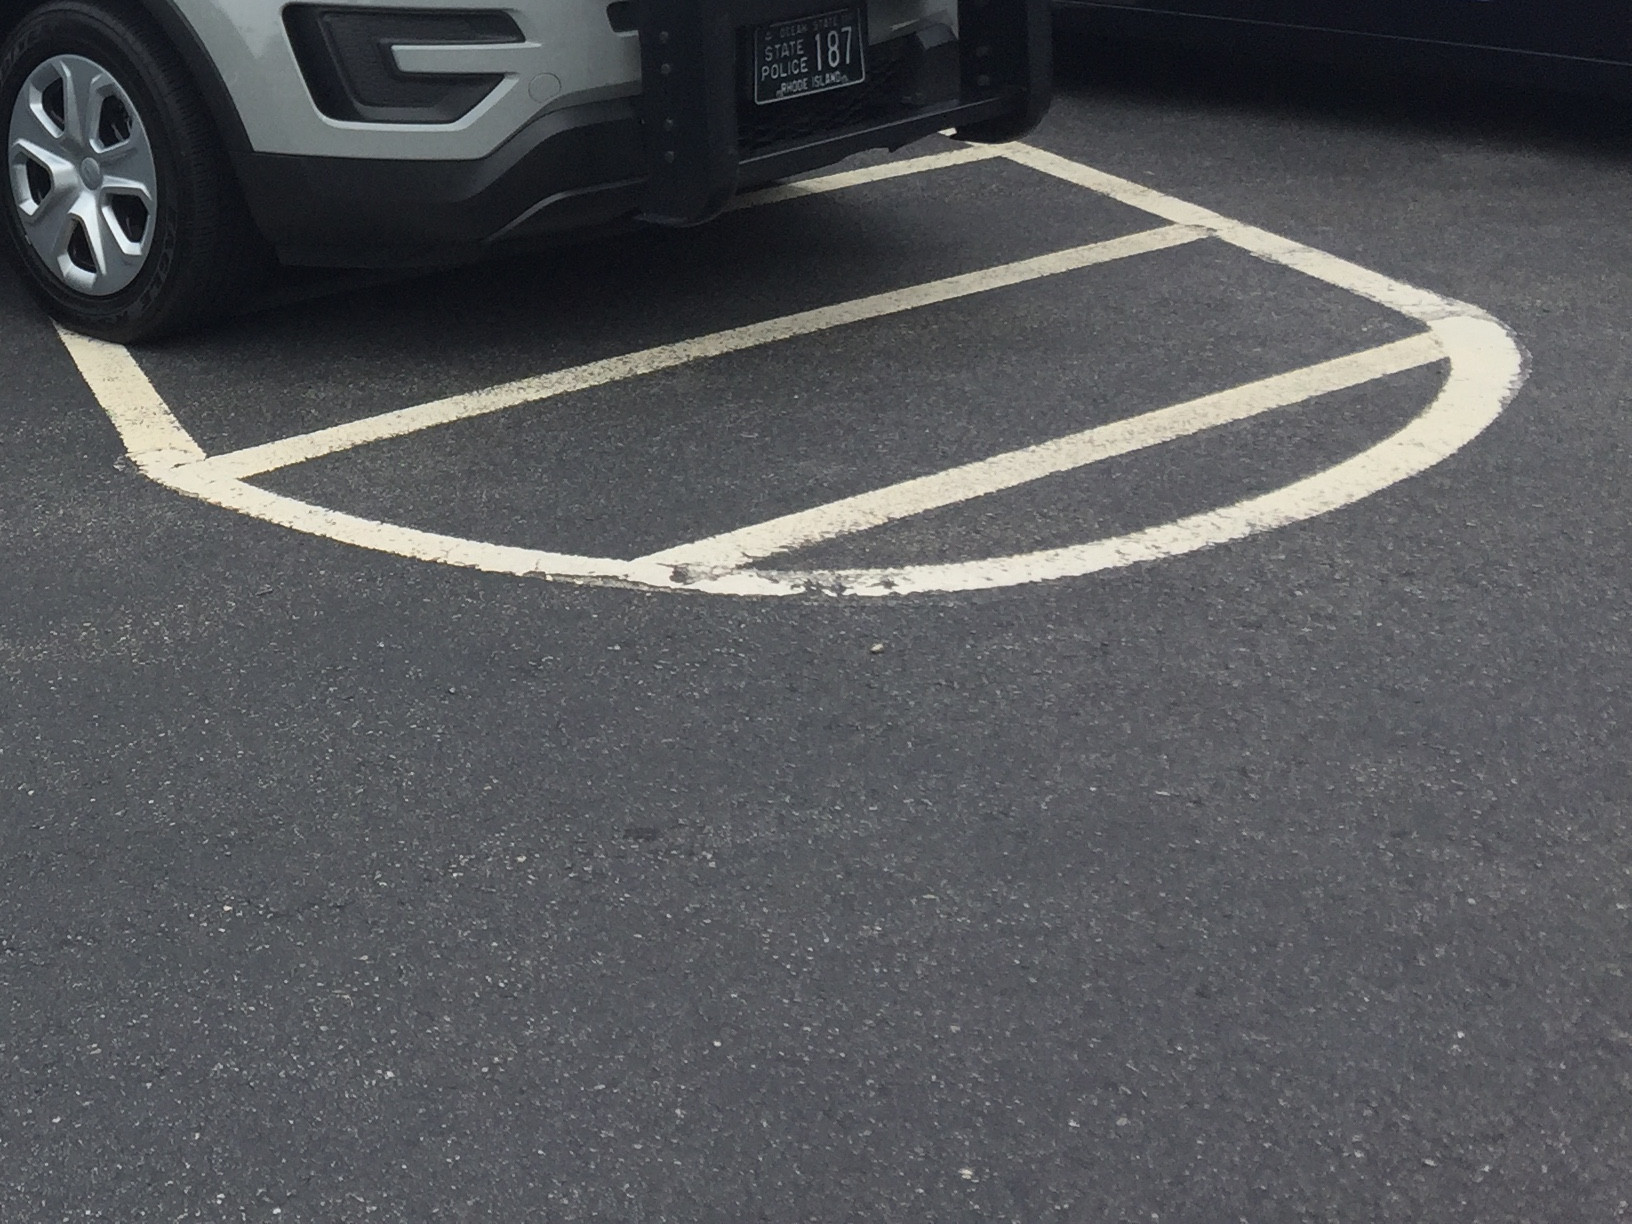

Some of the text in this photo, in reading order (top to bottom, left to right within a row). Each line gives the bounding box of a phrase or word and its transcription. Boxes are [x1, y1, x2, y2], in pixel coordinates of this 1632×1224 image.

[764, 39, 805, 62] STATE
[815, 26, 852, 72] 187
[761, 56, 809, 81] POLICE
[780, 70, 843, 94] RHODE ISLAND
